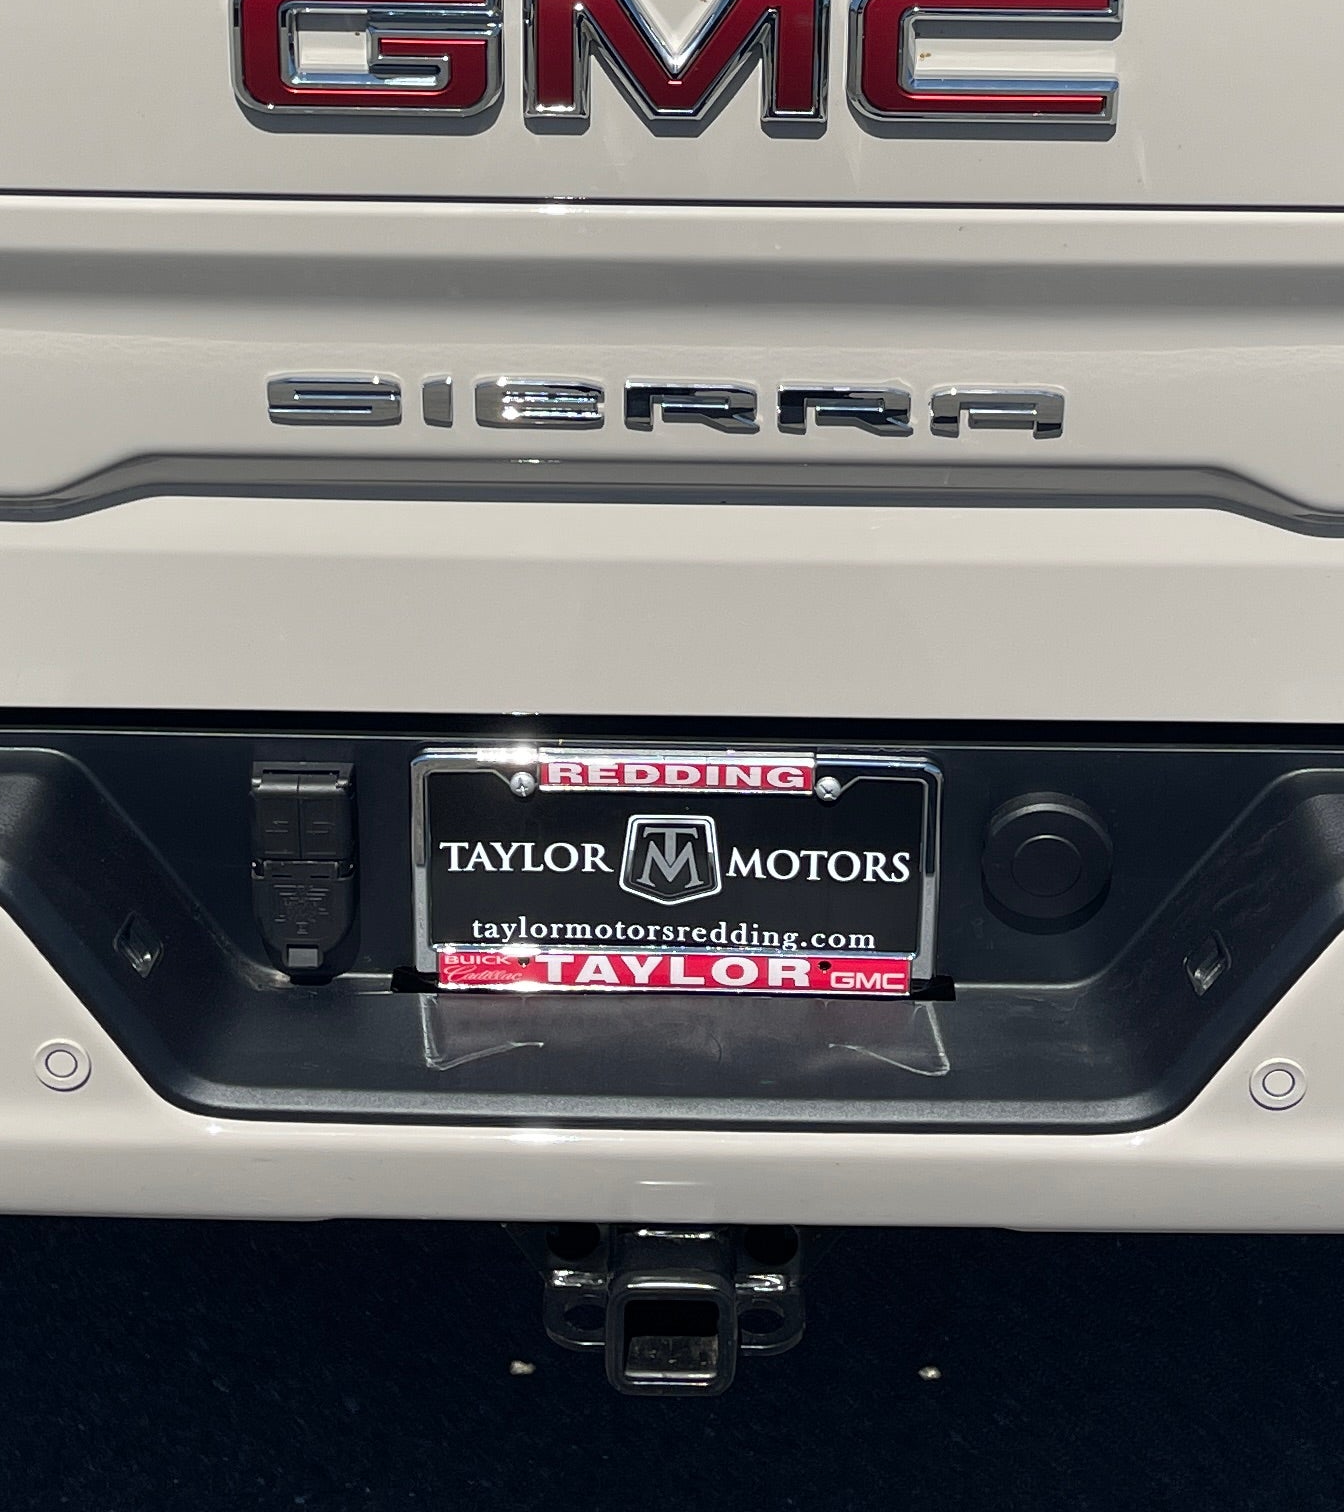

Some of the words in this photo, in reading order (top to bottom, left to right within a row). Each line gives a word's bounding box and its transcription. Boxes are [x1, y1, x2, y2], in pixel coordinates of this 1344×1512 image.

[266, 374, 1067, 438] SIERRA
[547, 762, 806, 789] REDDING
[439, 841, 614, 874] TAYLOR
[726, 846, 911, 884] MOTORS
[472, 915, 877, 951] taylormotorsredding.com
[443, 955, 511, 966] BUICK
[443, 965, 523, 983] Cadillac
[534, 954, 812, 988] TAYLOR
[829, 971, 907, 991] GMC
